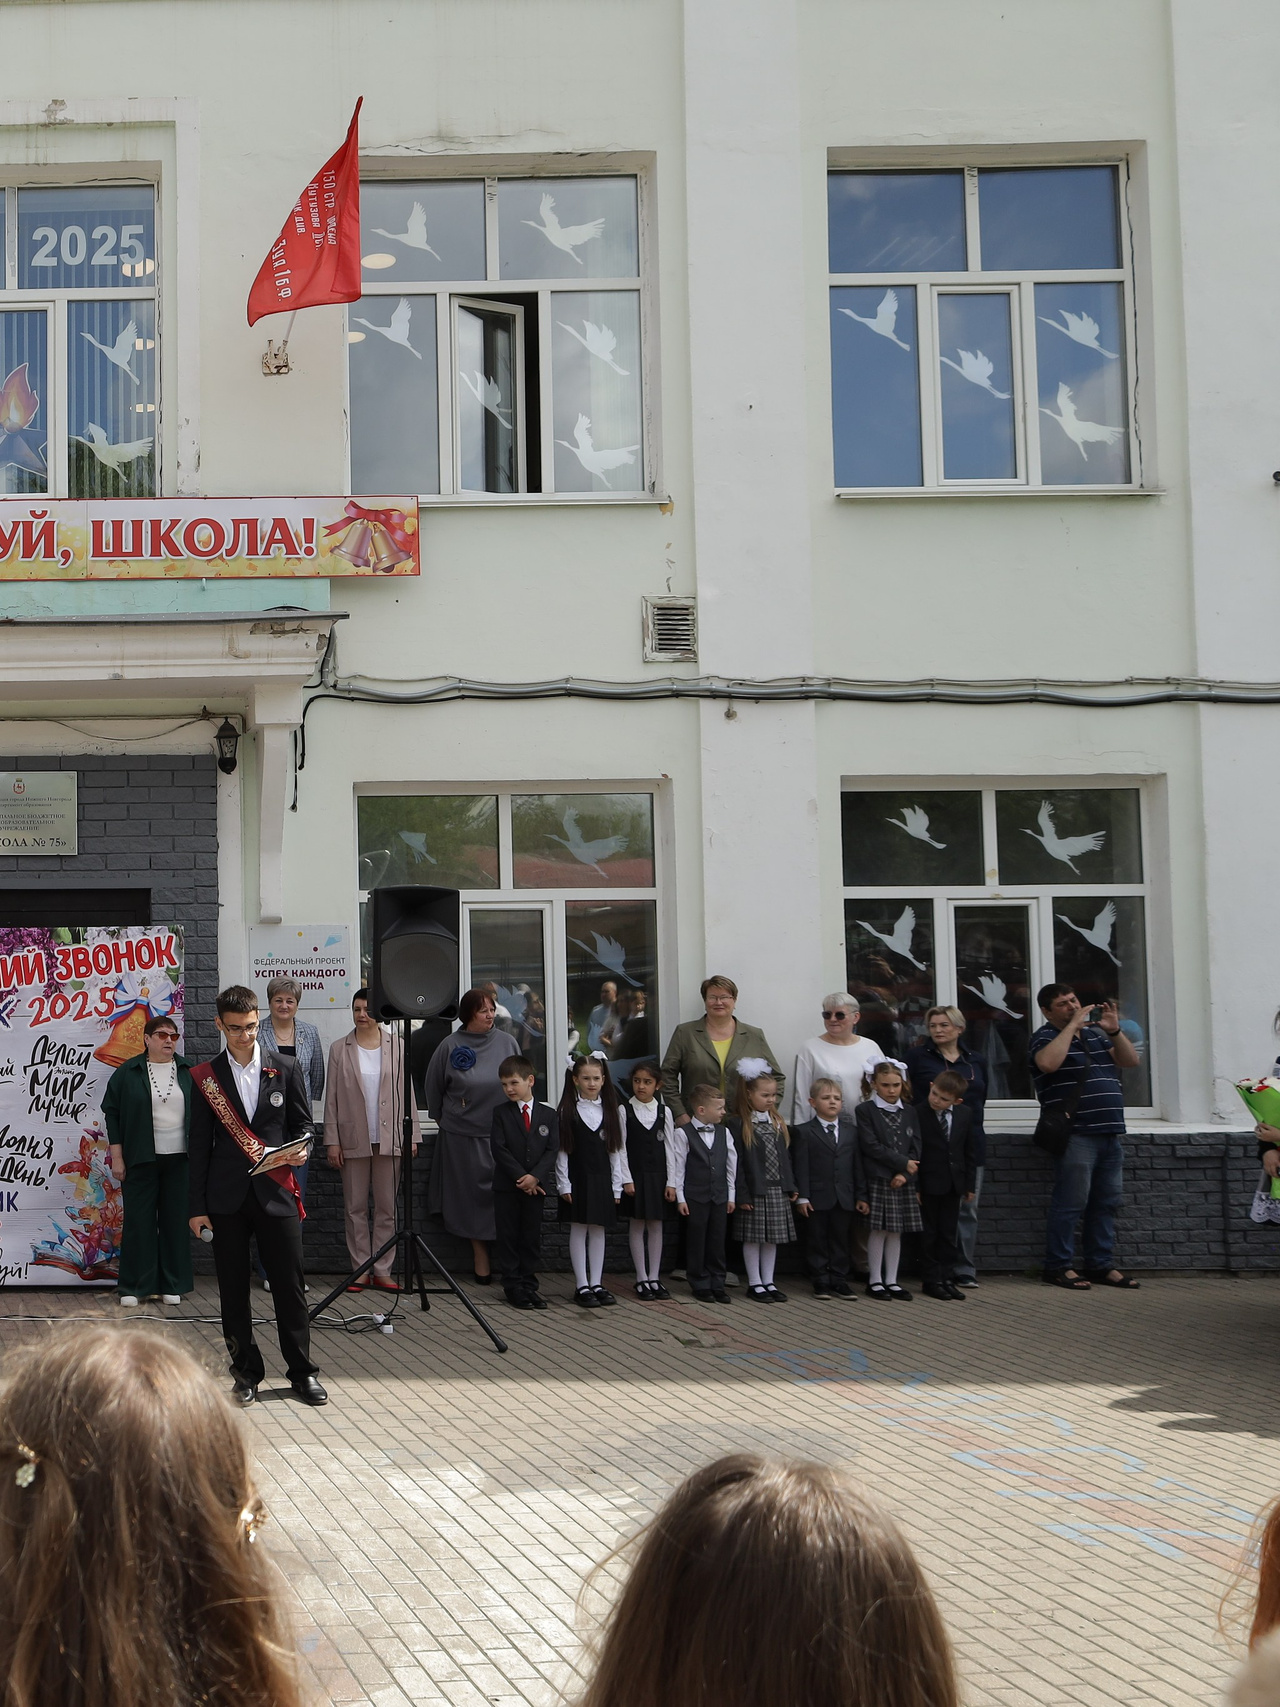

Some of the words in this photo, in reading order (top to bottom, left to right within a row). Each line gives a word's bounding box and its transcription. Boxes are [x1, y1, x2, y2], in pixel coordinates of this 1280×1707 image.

[30, 224, 145, 267] 2025
[91, 517, 316, 558] ШКОЛА!
[56, 935, 178, 982] ЗВОНОК
[254, 957, 313, 966] ФЕДЕРАЛЬНЫЙ
[315, 957, 346, 965] ПРОЕКТ
[254, 969, 288, 978] УСПЕХ
[291, 969, 346, 979] КАЖДОГО
[27, 988, 117, 1028] 2025
[243, 1139, 264, 1163] 202
